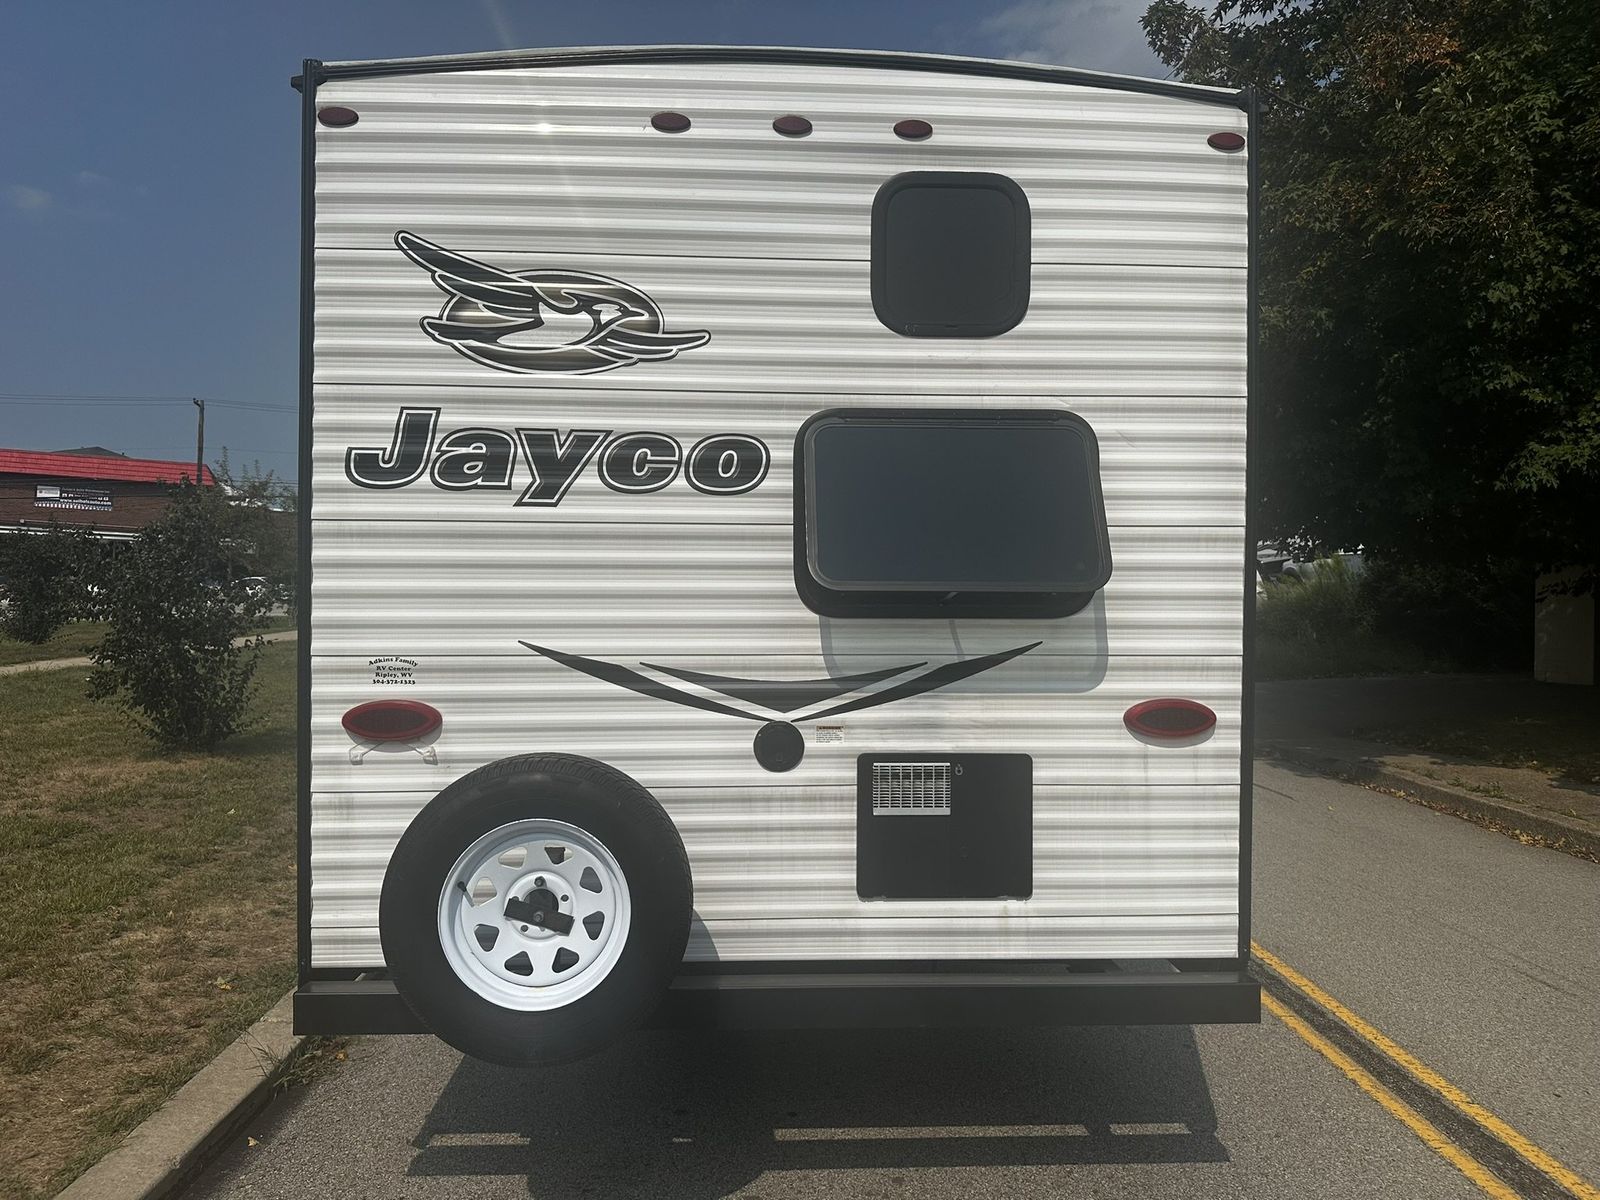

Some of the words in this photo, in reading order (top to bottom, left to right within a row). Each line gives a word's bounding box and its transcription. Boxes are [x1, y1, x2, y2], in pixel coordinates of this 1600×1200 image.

[344, 406, 771, 507] Jayco
[368, 657, 393, 666] Adkins
[395, 656, 418, 667] Family
